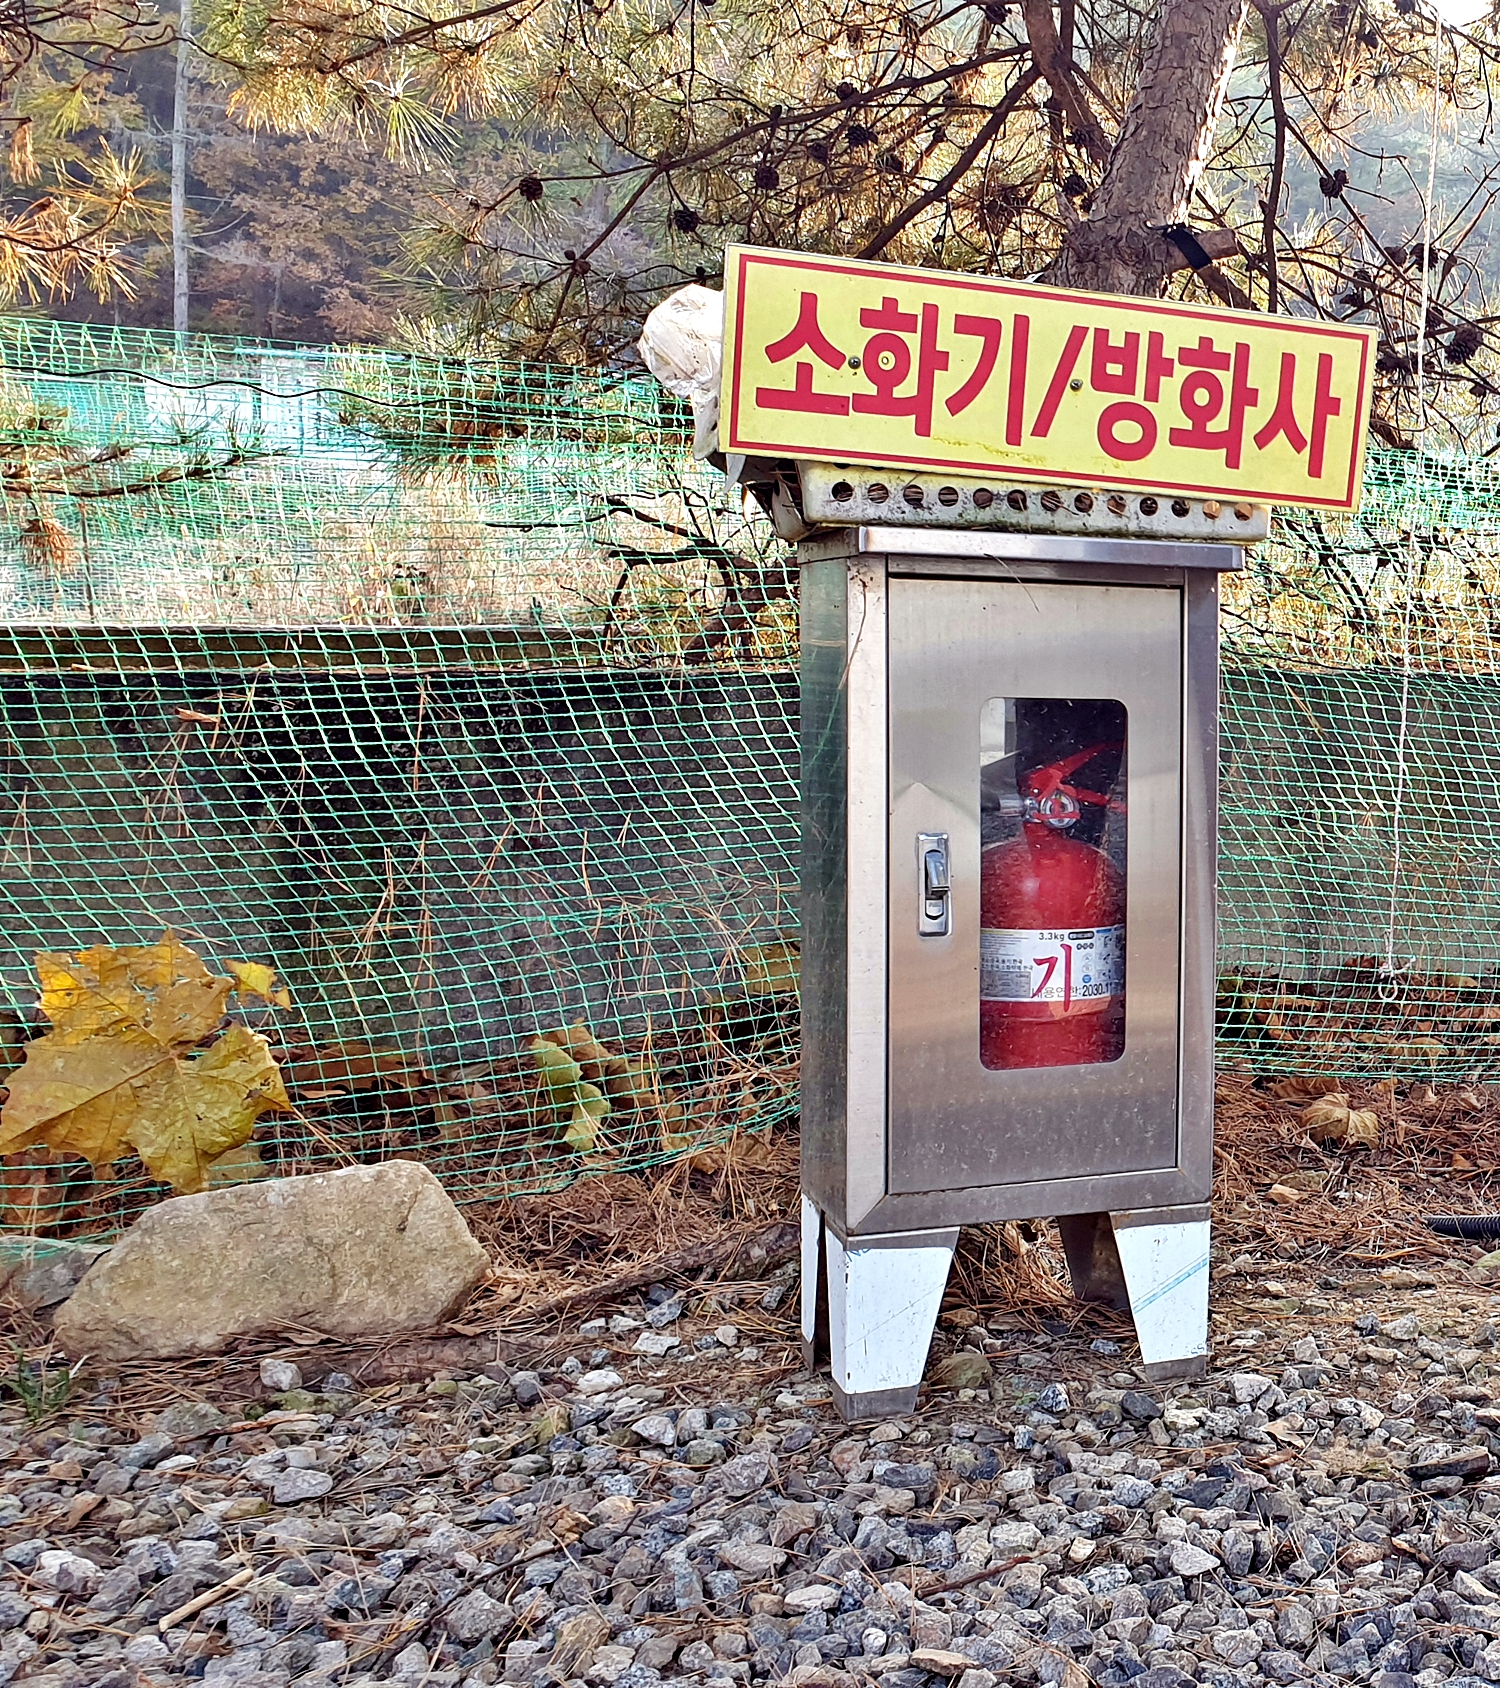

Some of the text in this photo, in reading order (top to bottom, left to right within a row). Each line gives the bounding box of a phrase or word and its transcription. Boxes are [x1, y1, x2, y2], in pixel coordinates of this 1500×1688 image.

[755, 291, 1342, 479] 소화기/방화사
[1038, 931, 1065, 942] 3.3kg
[1031, 943, 1072, 1012] 기
